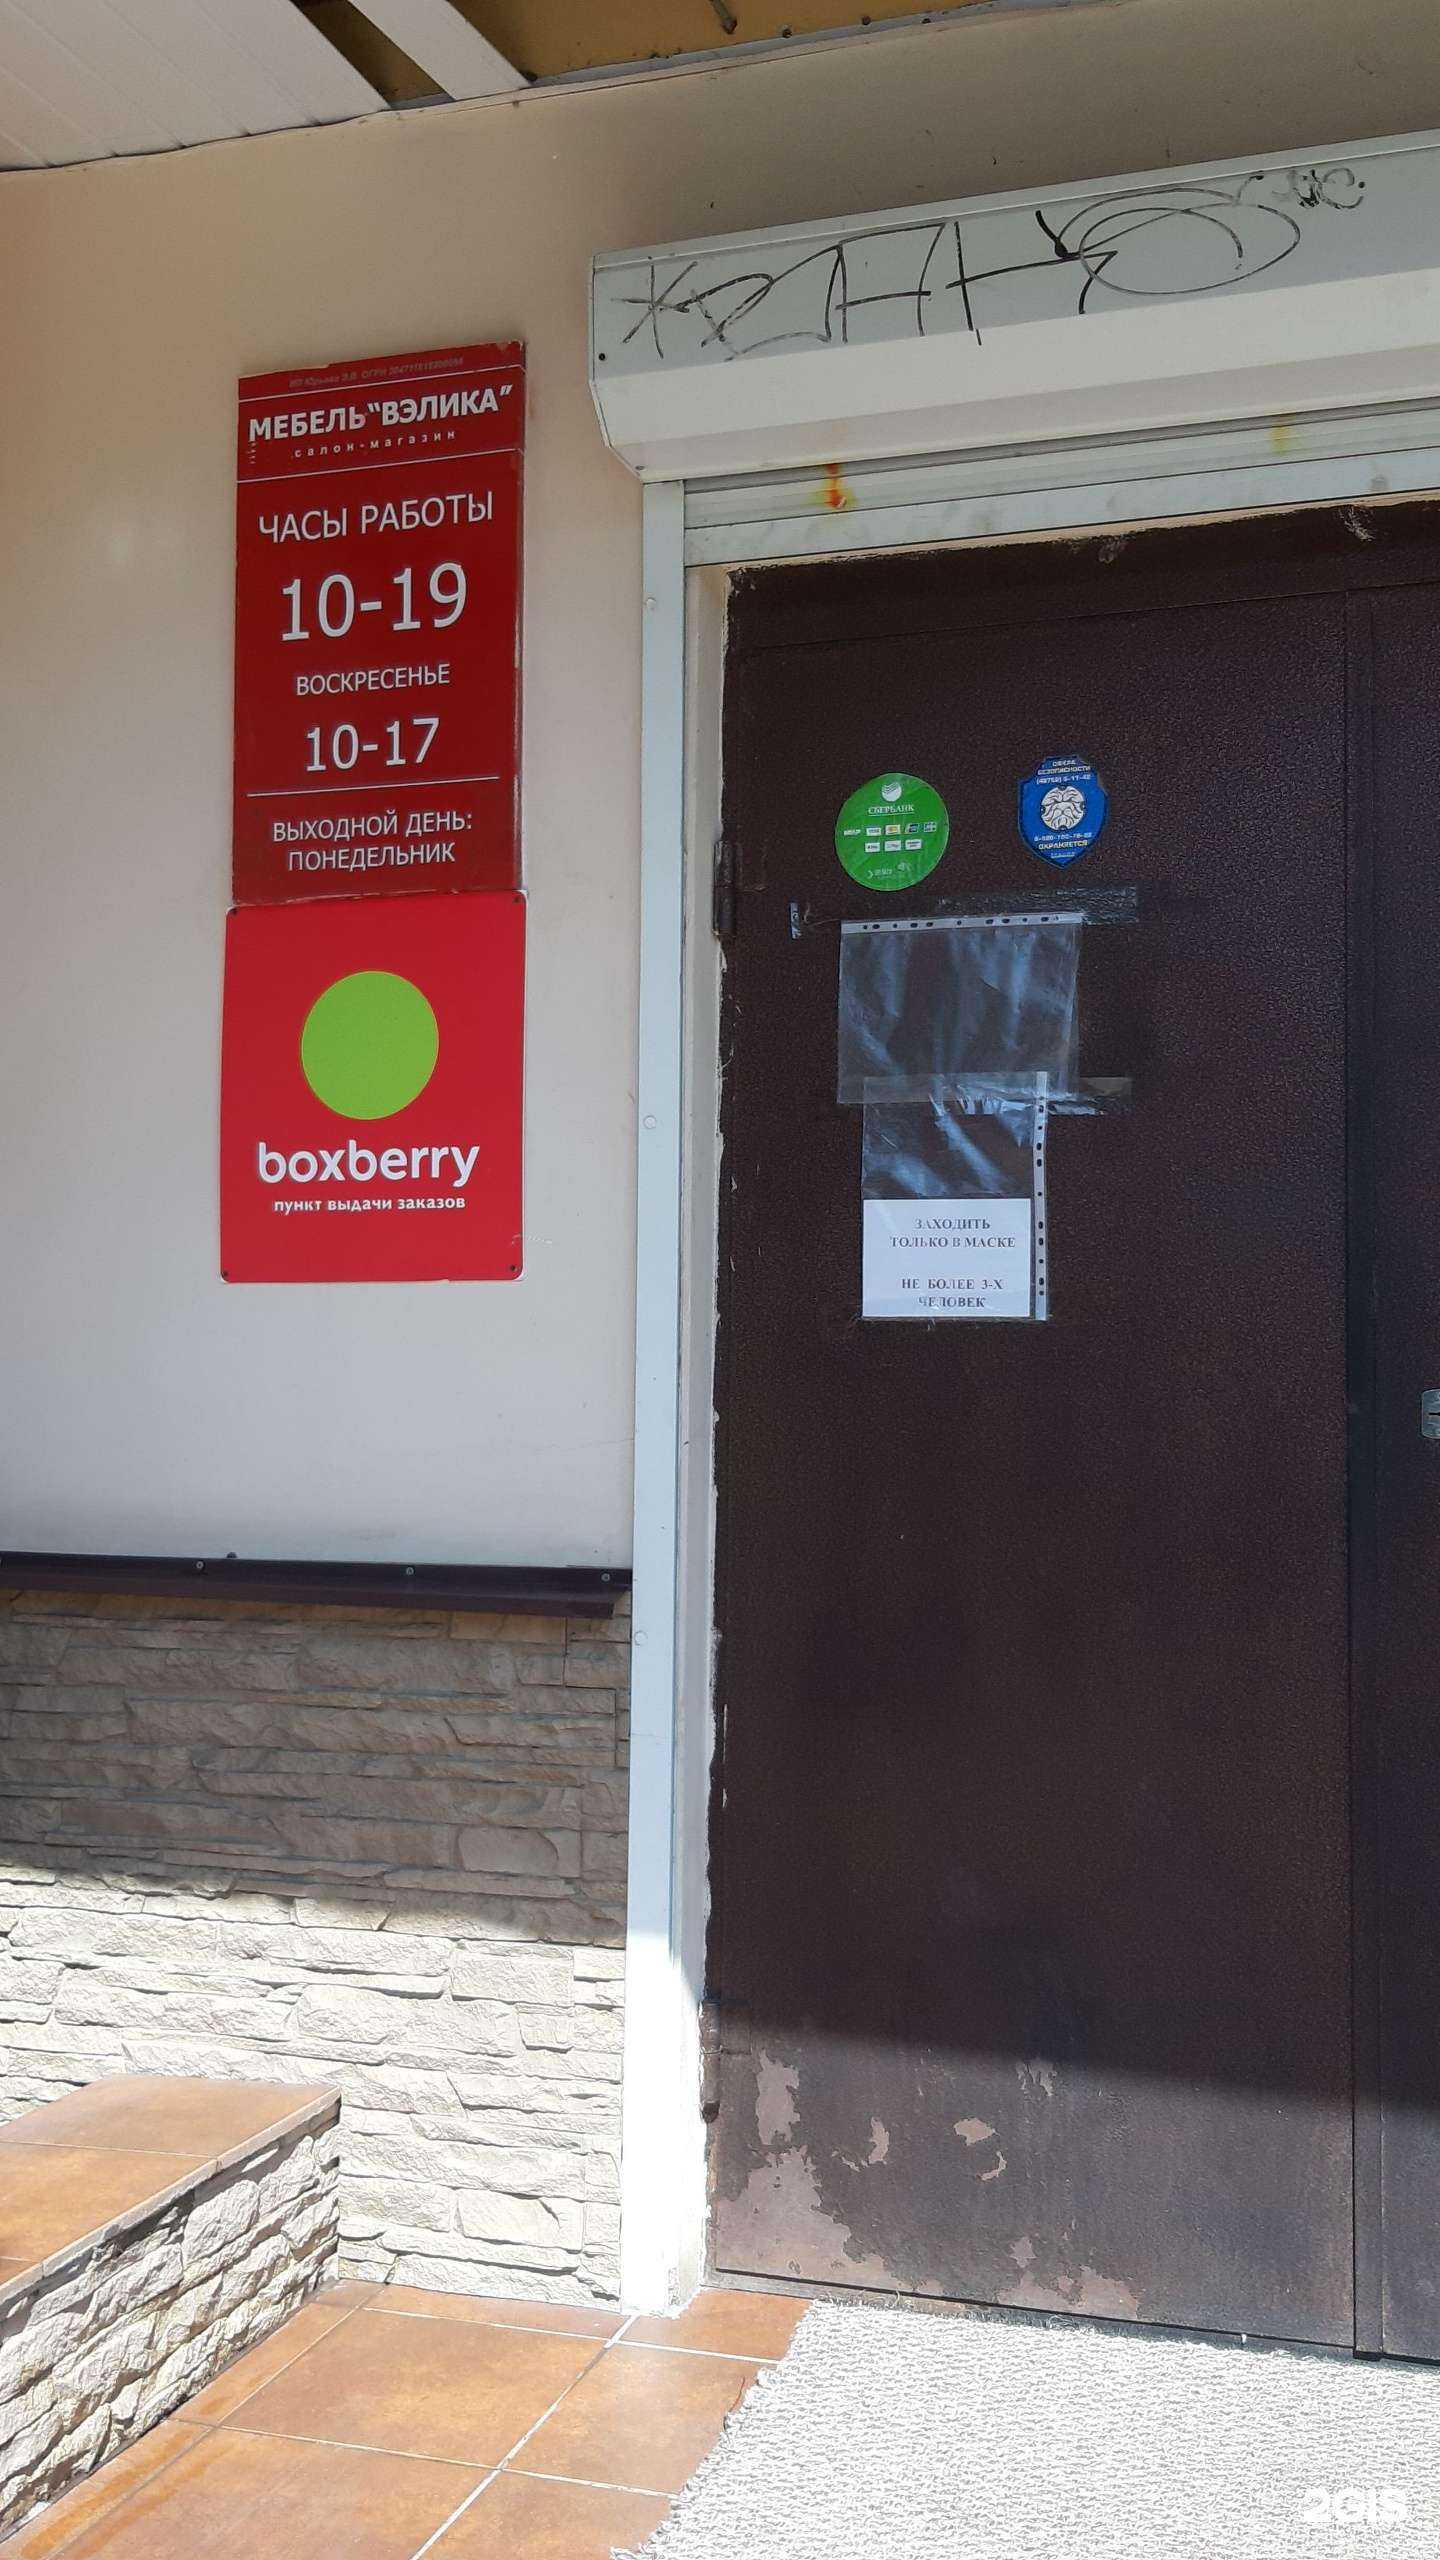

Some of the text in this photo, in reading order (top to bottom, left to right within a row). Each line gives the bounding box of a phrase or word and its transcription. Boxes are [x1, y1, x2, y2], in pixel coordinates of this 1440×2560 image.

[249, 406, 366, 442] МЕБЕЛЬ
[258, 491, 494, 544] ЧАСЫ РАБОТЫ
[281, 562, 468, 641] 10-19
[296, 664, 451, 696] ВОСКРЕСЕНЬЕ
[306, 717, 440, 772] 10-17
[272, 809, 473, 843] ВЫХОДНОЙ ДЕНЬ:
[288, 842, 456, 872] ПОНЕДЕЛЬНИК
[257, 1139, 481, 1188] boxberry
[273, 1196, 466, 1216] пункт выдачи заказов
[914, 1218, 991, 1231] ЗАХОДИТЬ
[890, 1236, 1016, 1249] ТОЛЬКО В МАСКЕ
[902, 1278, 921, 1289] НЕ
[928, 1278, 975, 1289] БОЛЕЕ
[918, 1296, 987, 1309] ЧЕЛОВЕК
